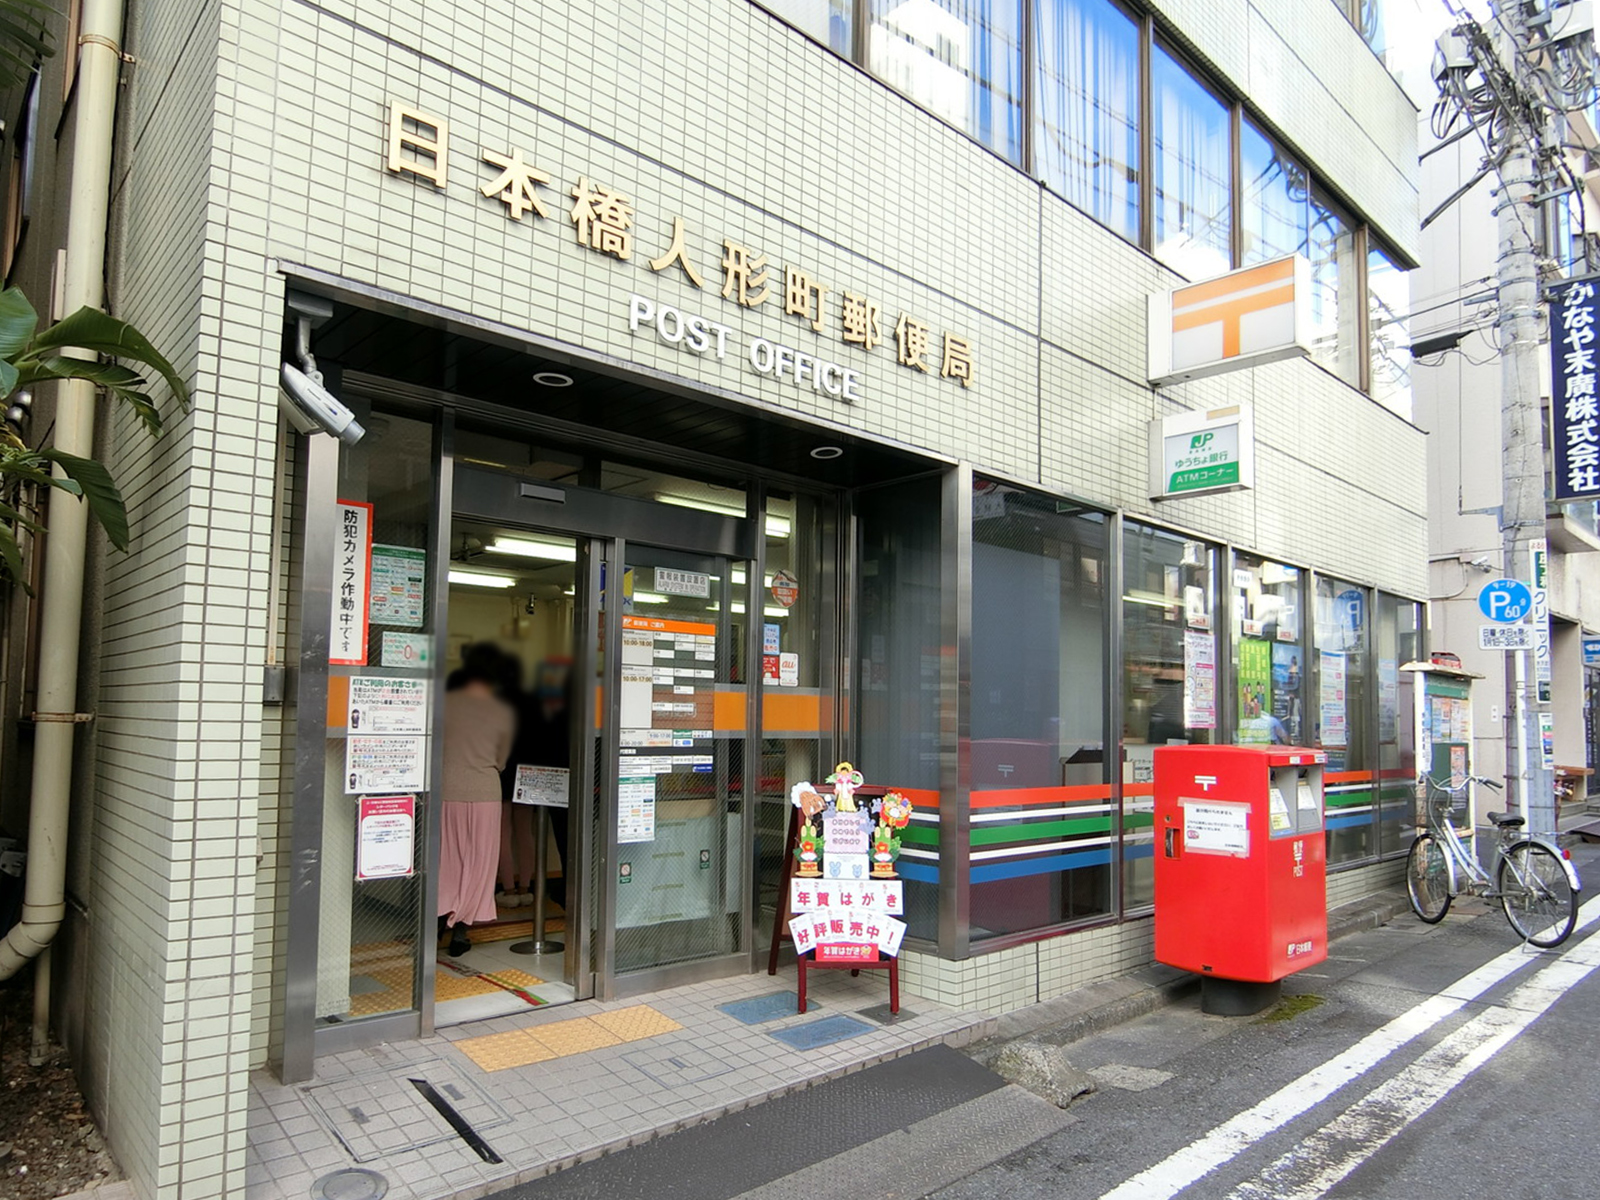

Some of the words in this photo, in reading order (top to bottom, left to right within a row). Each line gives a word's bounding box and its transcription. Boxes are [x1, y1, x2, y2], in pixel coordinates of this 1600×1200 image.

[385, 98, 978, 390] 日本橋人形町郵便局
[628, 294, 732, 359] POST
[749, 335, 863, 403] OFFICE
[1562, 282, 1600, 493] かなや末廣株式会社
[1175, 450, 1228, 468] ゆうちょ銀行
[1176, 468, 1234, 484] ATMコーナー
[339, 509, 358, 652] 防犯カメラ作動中です
[1492, 581, 1516, 589] 9-19
[1489, 591, 1511, 619] P
[1534, 591, 1548, 659] クリニック
[782, 661, 795, 669] au
[797, 891, 897, 908] 年賀はがき
[797, 919, 895, 946] 好評販売中!
[823, 946, 860, 956] 年賀はがき
